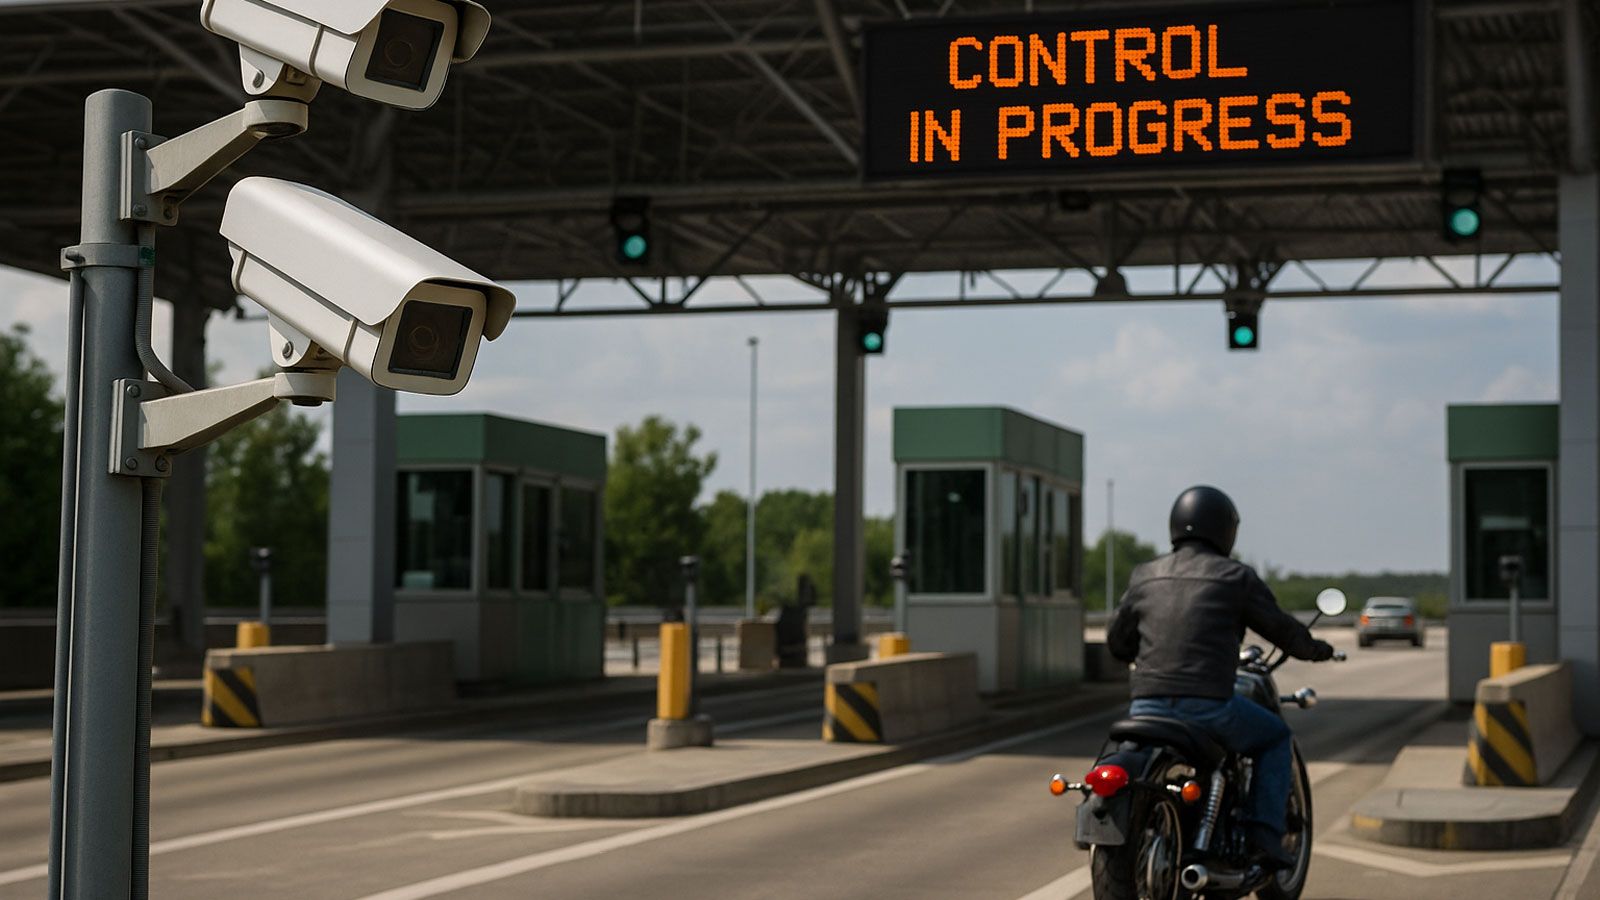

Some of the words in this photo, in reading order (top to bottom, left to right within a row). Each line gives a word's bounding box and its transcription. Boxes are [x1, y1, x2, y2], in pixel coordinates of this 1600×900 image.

[949, 24, 1248, 90] CONTROL
[909, 109, 961, 163] IN
[997, 90, 1353, 161] PROGRESS
